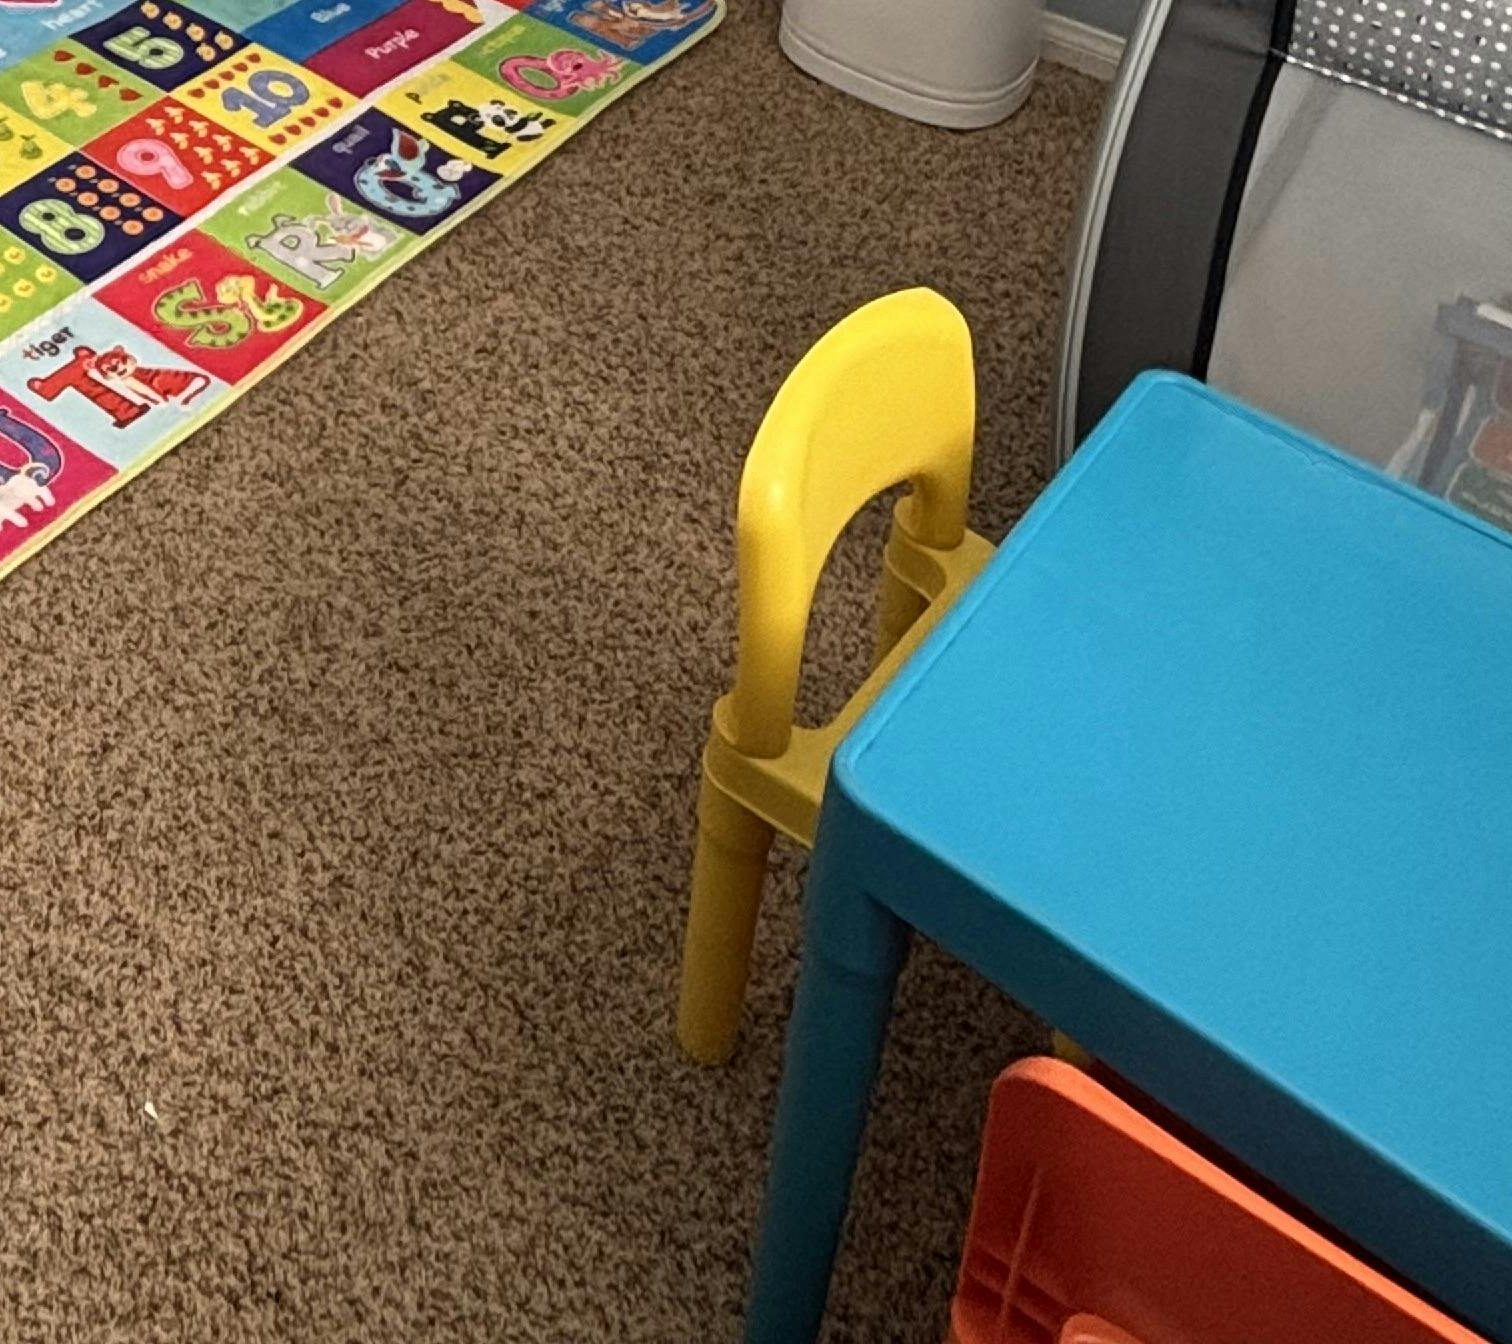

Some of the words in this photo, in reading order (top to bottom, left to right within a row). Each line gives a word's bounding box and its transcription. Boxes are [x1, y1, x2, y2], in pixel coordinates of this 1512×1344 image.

[309, 2, 352, 24] Blue
[102, 25, 185, 70] 5
[364, 26, 421, 60] Purple
[20, 80, 98, 120] 4
[220, 69, 310, 129] 10
[116, 138, 194, 190] 9
[18, 198, 106, 255] 8
[138, 247, 193, 284] snake
[21, 324, 76, 362] tiger
